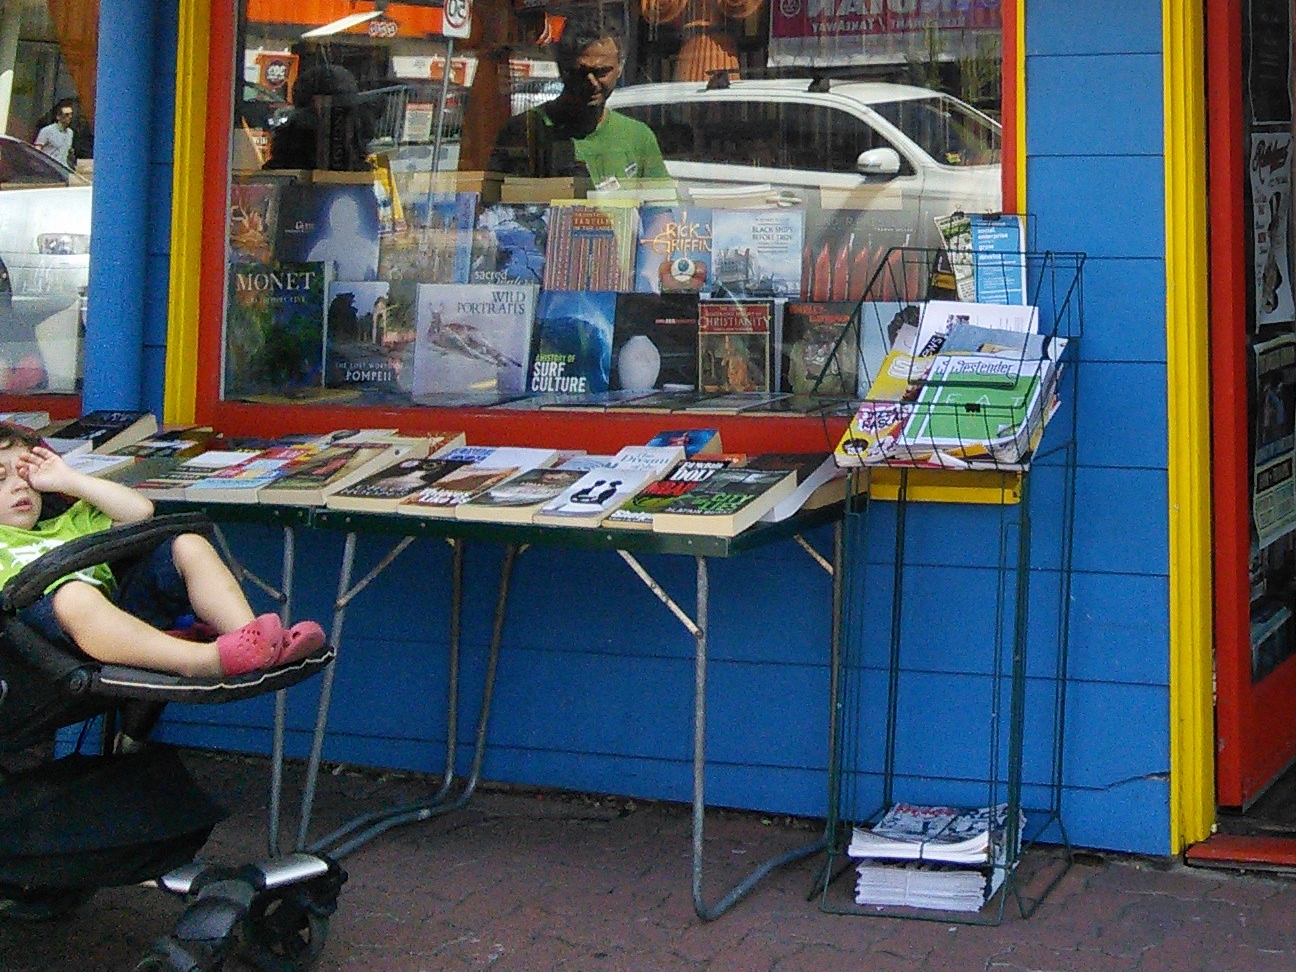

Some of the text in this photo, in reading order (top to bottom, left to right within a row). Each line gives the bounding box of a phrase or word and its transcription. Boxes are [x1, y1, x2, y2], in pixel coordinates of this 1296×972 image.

[665, 222, 699, 238] RICK
[235, 271, 317, 292] MONET
[491, 290, 526, 303] WILD
[698, 315, 771, 329] CHRISTIANITY
[533, 362, 565, 378] SURF
[950, 360, 1015, 376] Westender
[345, 370, 392, 383] POMPEII
[531, 377, 587, 393] CULTURE
